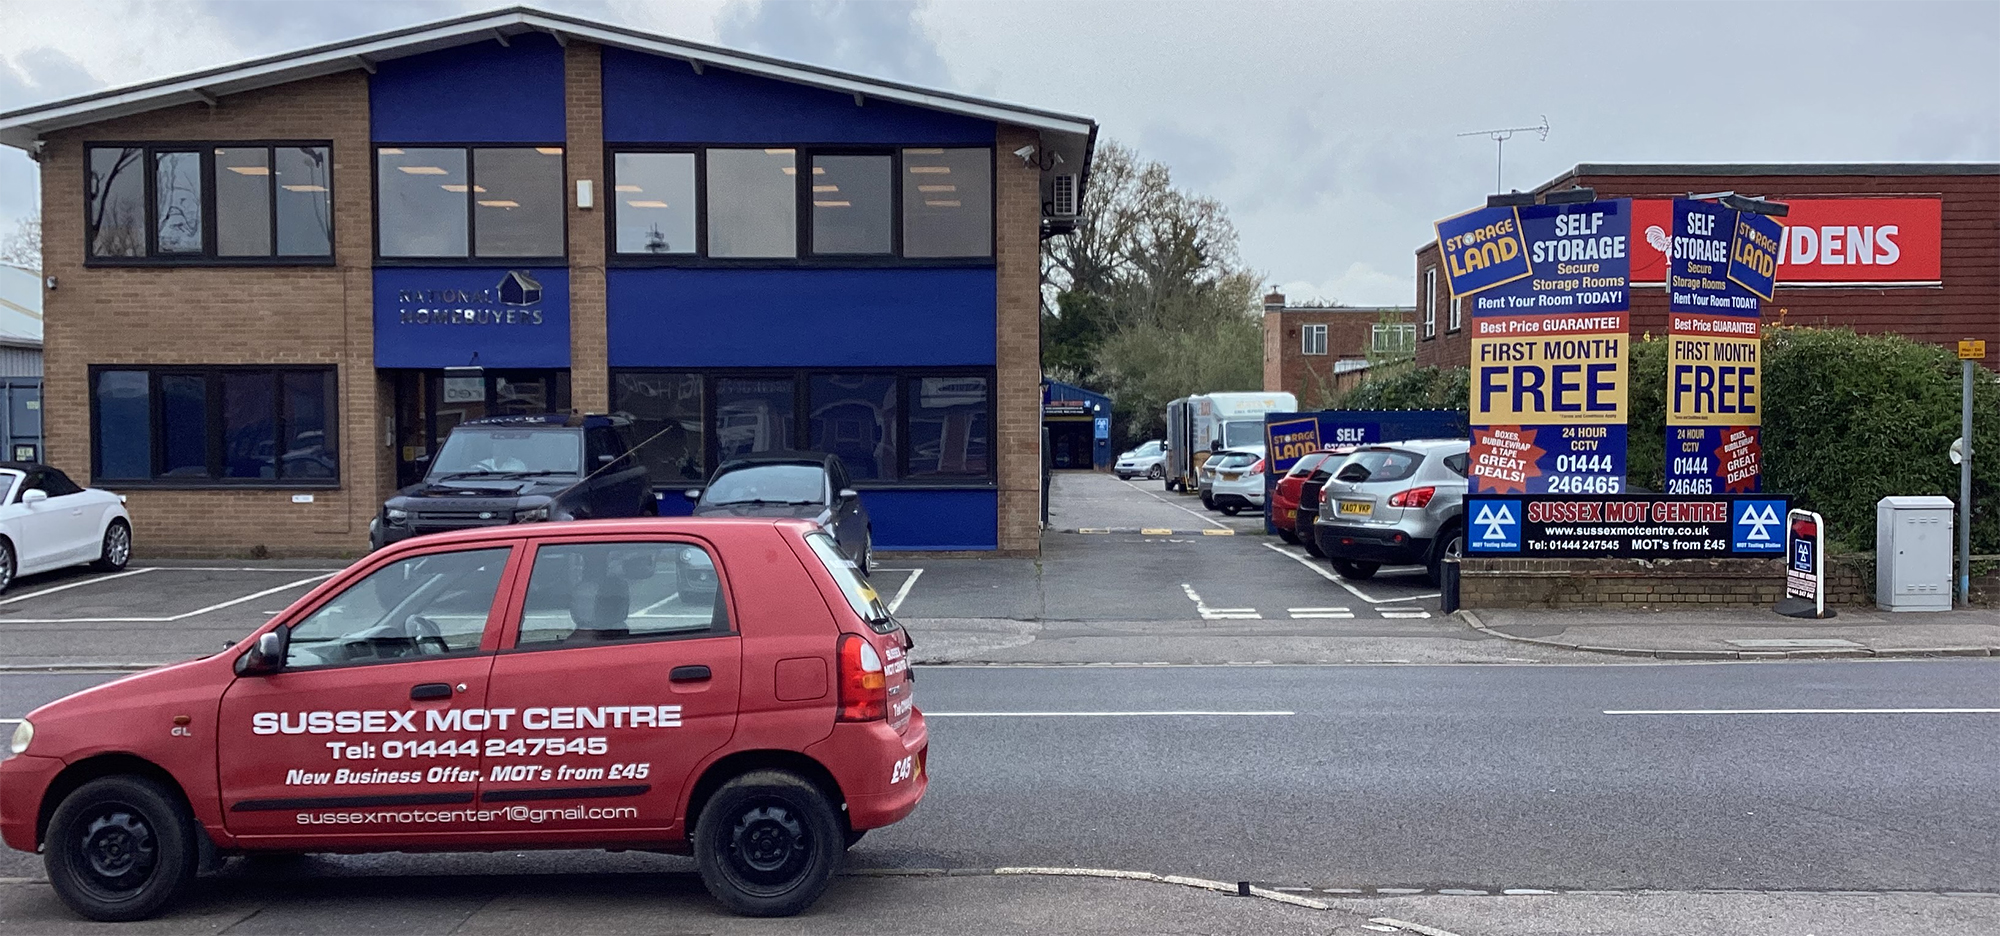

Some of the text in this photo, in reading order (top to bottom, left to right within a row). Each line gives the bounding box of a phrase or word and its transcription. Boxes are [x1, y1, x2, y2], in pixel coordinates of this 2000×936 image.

[1555, 212, 1603, 237] SELF
[1687, 212, 1715, 236] SELF
[1446, 218, 1514, 252] STORAGE
[1739, 222, 1777, 254] STORAGE
[1532, 236, 1626, 264] STORAGE
[1674, 236, 1727, 263] STORAGE
[1778, 225, 1900, 265] DENS
[1449, 236, 1519, 278] LAND
[1735, 238, 1774, 278] LAND
[1557, 262, 1600, 275] Secure
[1687, 261, 1712, 275] Secure
[1533, 277, 1625, 292] Storage Rooms
[1672, 275, 1726, 290] Storage Rooms
[1478, 291, 1622, 309] Rent Your Room TODAY!
[1673, 292, 1757, 309] Rent Your Room TODAY!
[400, 309, 543, 325] HOMEBUYERS
[1480, 317, 1620, 333] Best Price GUARANTEE!
[1674, 318, 1756, 334] Best Price GUARANTEE!
[1480, 339, 1618, 361] FIRST MONTH
[1675, 341, 1756, 362] FIRST MONTH
[1480, 363, 1617, 413] FREE
[1674, 365, 1756, 414] FREE
[1274, 430, 1315, 444] STORAGE
[1336, 428, 1365, 441] SELF
[1494, 429, 1520, 442] BOXES,
[1562, 427, 1607, 438] 24 HOUR
[1677, 429, 1705, 439] 24 HOUR
[1274, 441, 1317, 460] LAND
[1482, 436, 1531, 451] BUBBLEWRAP
[1491, 446, 1518, 458] & TAPE
[1570, 440, 1598, 451] CCTV
[1682, 441, 1700, 453] CCTV
[1479, 453, 1526, 471] GREAT
[1556, 454, 1613, 473] 01444
[1673, 456, 1708, 475] 01444
[1727, 452, 1756, 472] GREAT
[1474, 464, 1525, 483] DEALS!
[1727, 463, 1759, 484] DEALS!
[1548, 475, 1620, 494] 246465
[1668, 478, 1713, 495] 246465
[1528, 501, 1728, 523] SUSSEX MOT CENTRE
[1545, 525, 1709, 536] www.sussexmotcentre.co.uk
[1528, 540, 1620, 550] Tel: 01444 247545
[1631, 539, 1726, 550] MOT's from £45
[252, 705, 682, 735] SUSSEX MOT CENTRE
[170, 727, 192, 737] GL
[326, 736, 608, 759] Tel: 01444 247545
[285, 763, 650, 785] New Business Offer. MOT's from £45
[890, 755, 912, 784] £45
[296, 804, 637, 825] sussexmotcenter1@gmail.com
